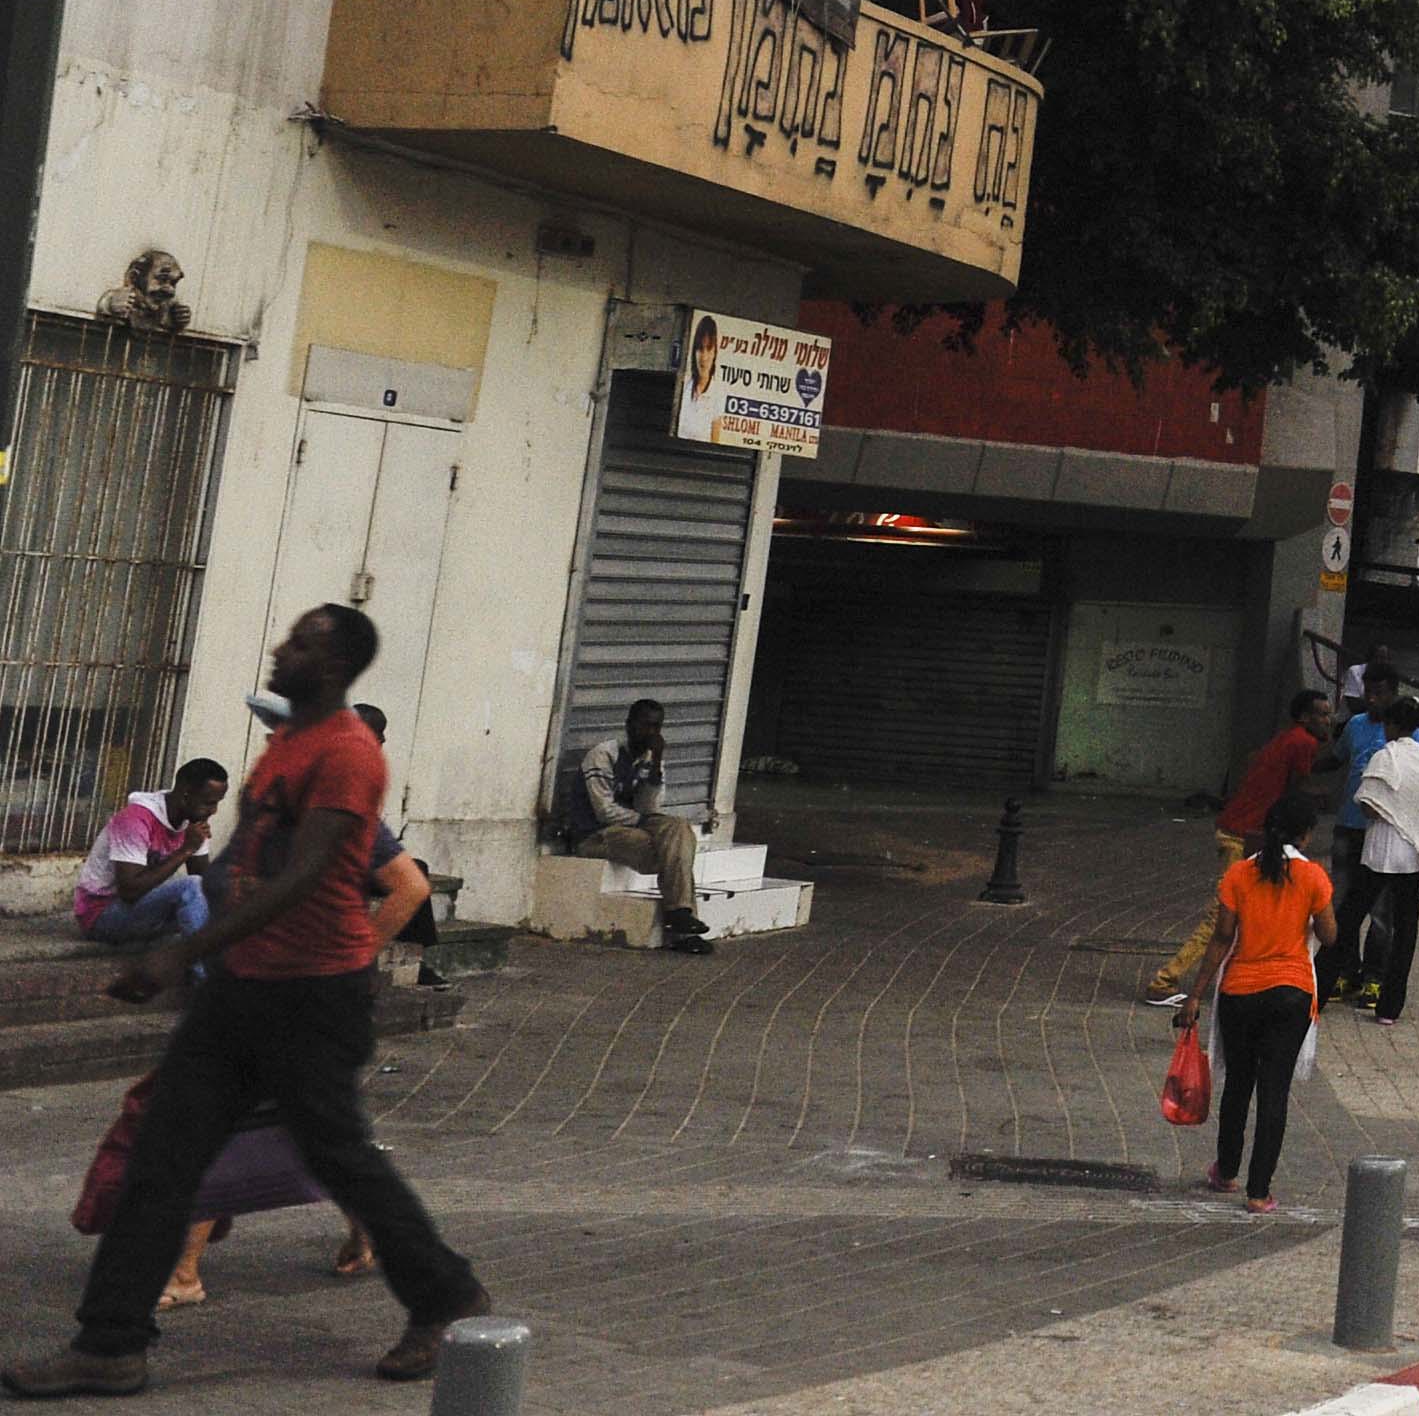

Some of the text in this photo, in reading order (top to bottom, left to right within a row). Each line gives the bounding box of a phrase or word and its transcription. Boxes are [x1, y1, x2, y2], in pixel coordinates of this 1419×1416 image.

[750, 328, 788, 362] מנילה
[794, 338, 830, 370] שלומי
[720, 364, 751, 386] סיעוד
[756, 371, 792, 394] שרותי
[727, 397, 821, 427] 03-6397161
[722, 415, 761, 435] SHLOMI
[770, 422, 808, 443] MANILA
[742, 437, 803, 453] לוינסקי 104
